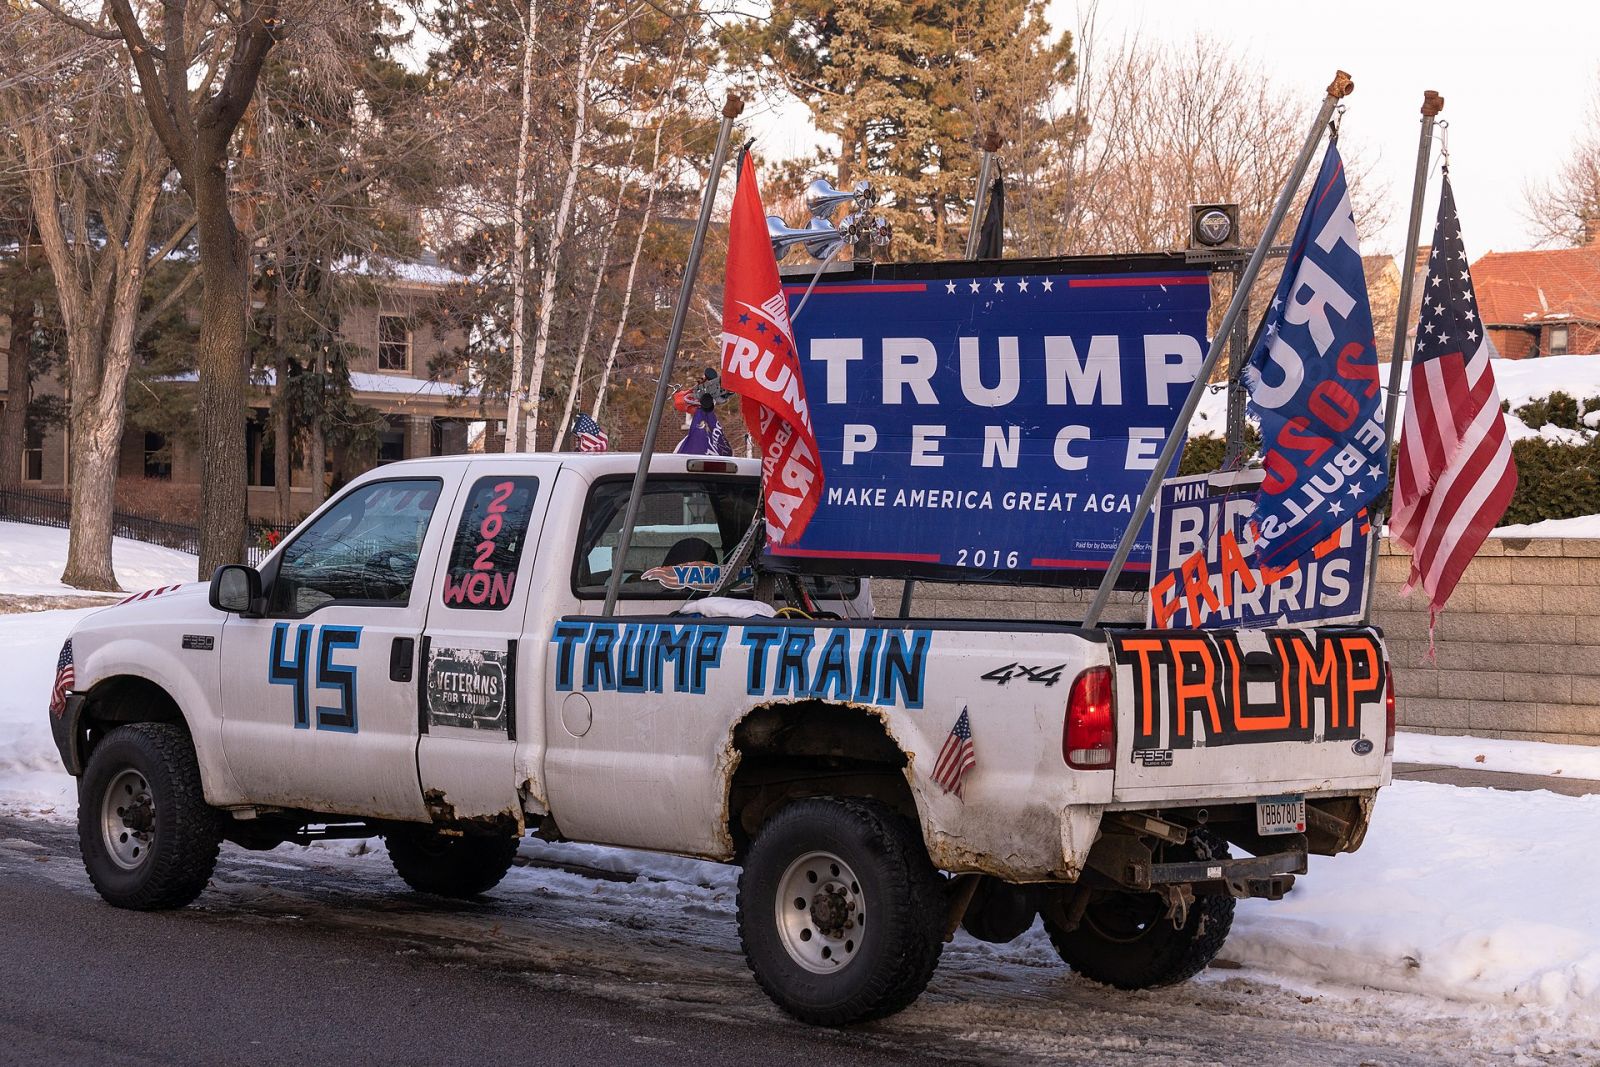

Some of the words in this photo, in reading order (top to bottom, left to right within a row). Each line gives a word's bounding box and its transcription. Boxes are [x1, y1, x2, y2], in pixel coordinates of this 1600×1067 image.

[721, 331, 812, 438] TRUM
[810, 334, 1203, 407] TRUMP
[842, 424, 1165, 471] PENCE
[827, 487, 887, 507] MAKE
[893, 489, 993, 509] AMERICA
[1002, 491, 1077, 511] GREAT
[1174, 483, 1209, 502] MIN
[957, 549, 1018, 569] 2016
[1075, 541, 1086, 549] Paid
[1094, 542, 1100, 550] by
[1100, 542, 1118, 550] Donald
[444, 573, 515, 605] WON
[269, 622, 363, 734] 45
[550, 621, 729, 693] TRUMP
[739, 625, 932, 709] TRAIN
[436, 671, 498, 695] VETERANS
[1117, 632, 1384, 745] TRUMP
[442, 692, 459, 703] FOR
[461, 693, 490, 705] TRUMP
[1260, 803, 1297, 826] YBB6780
